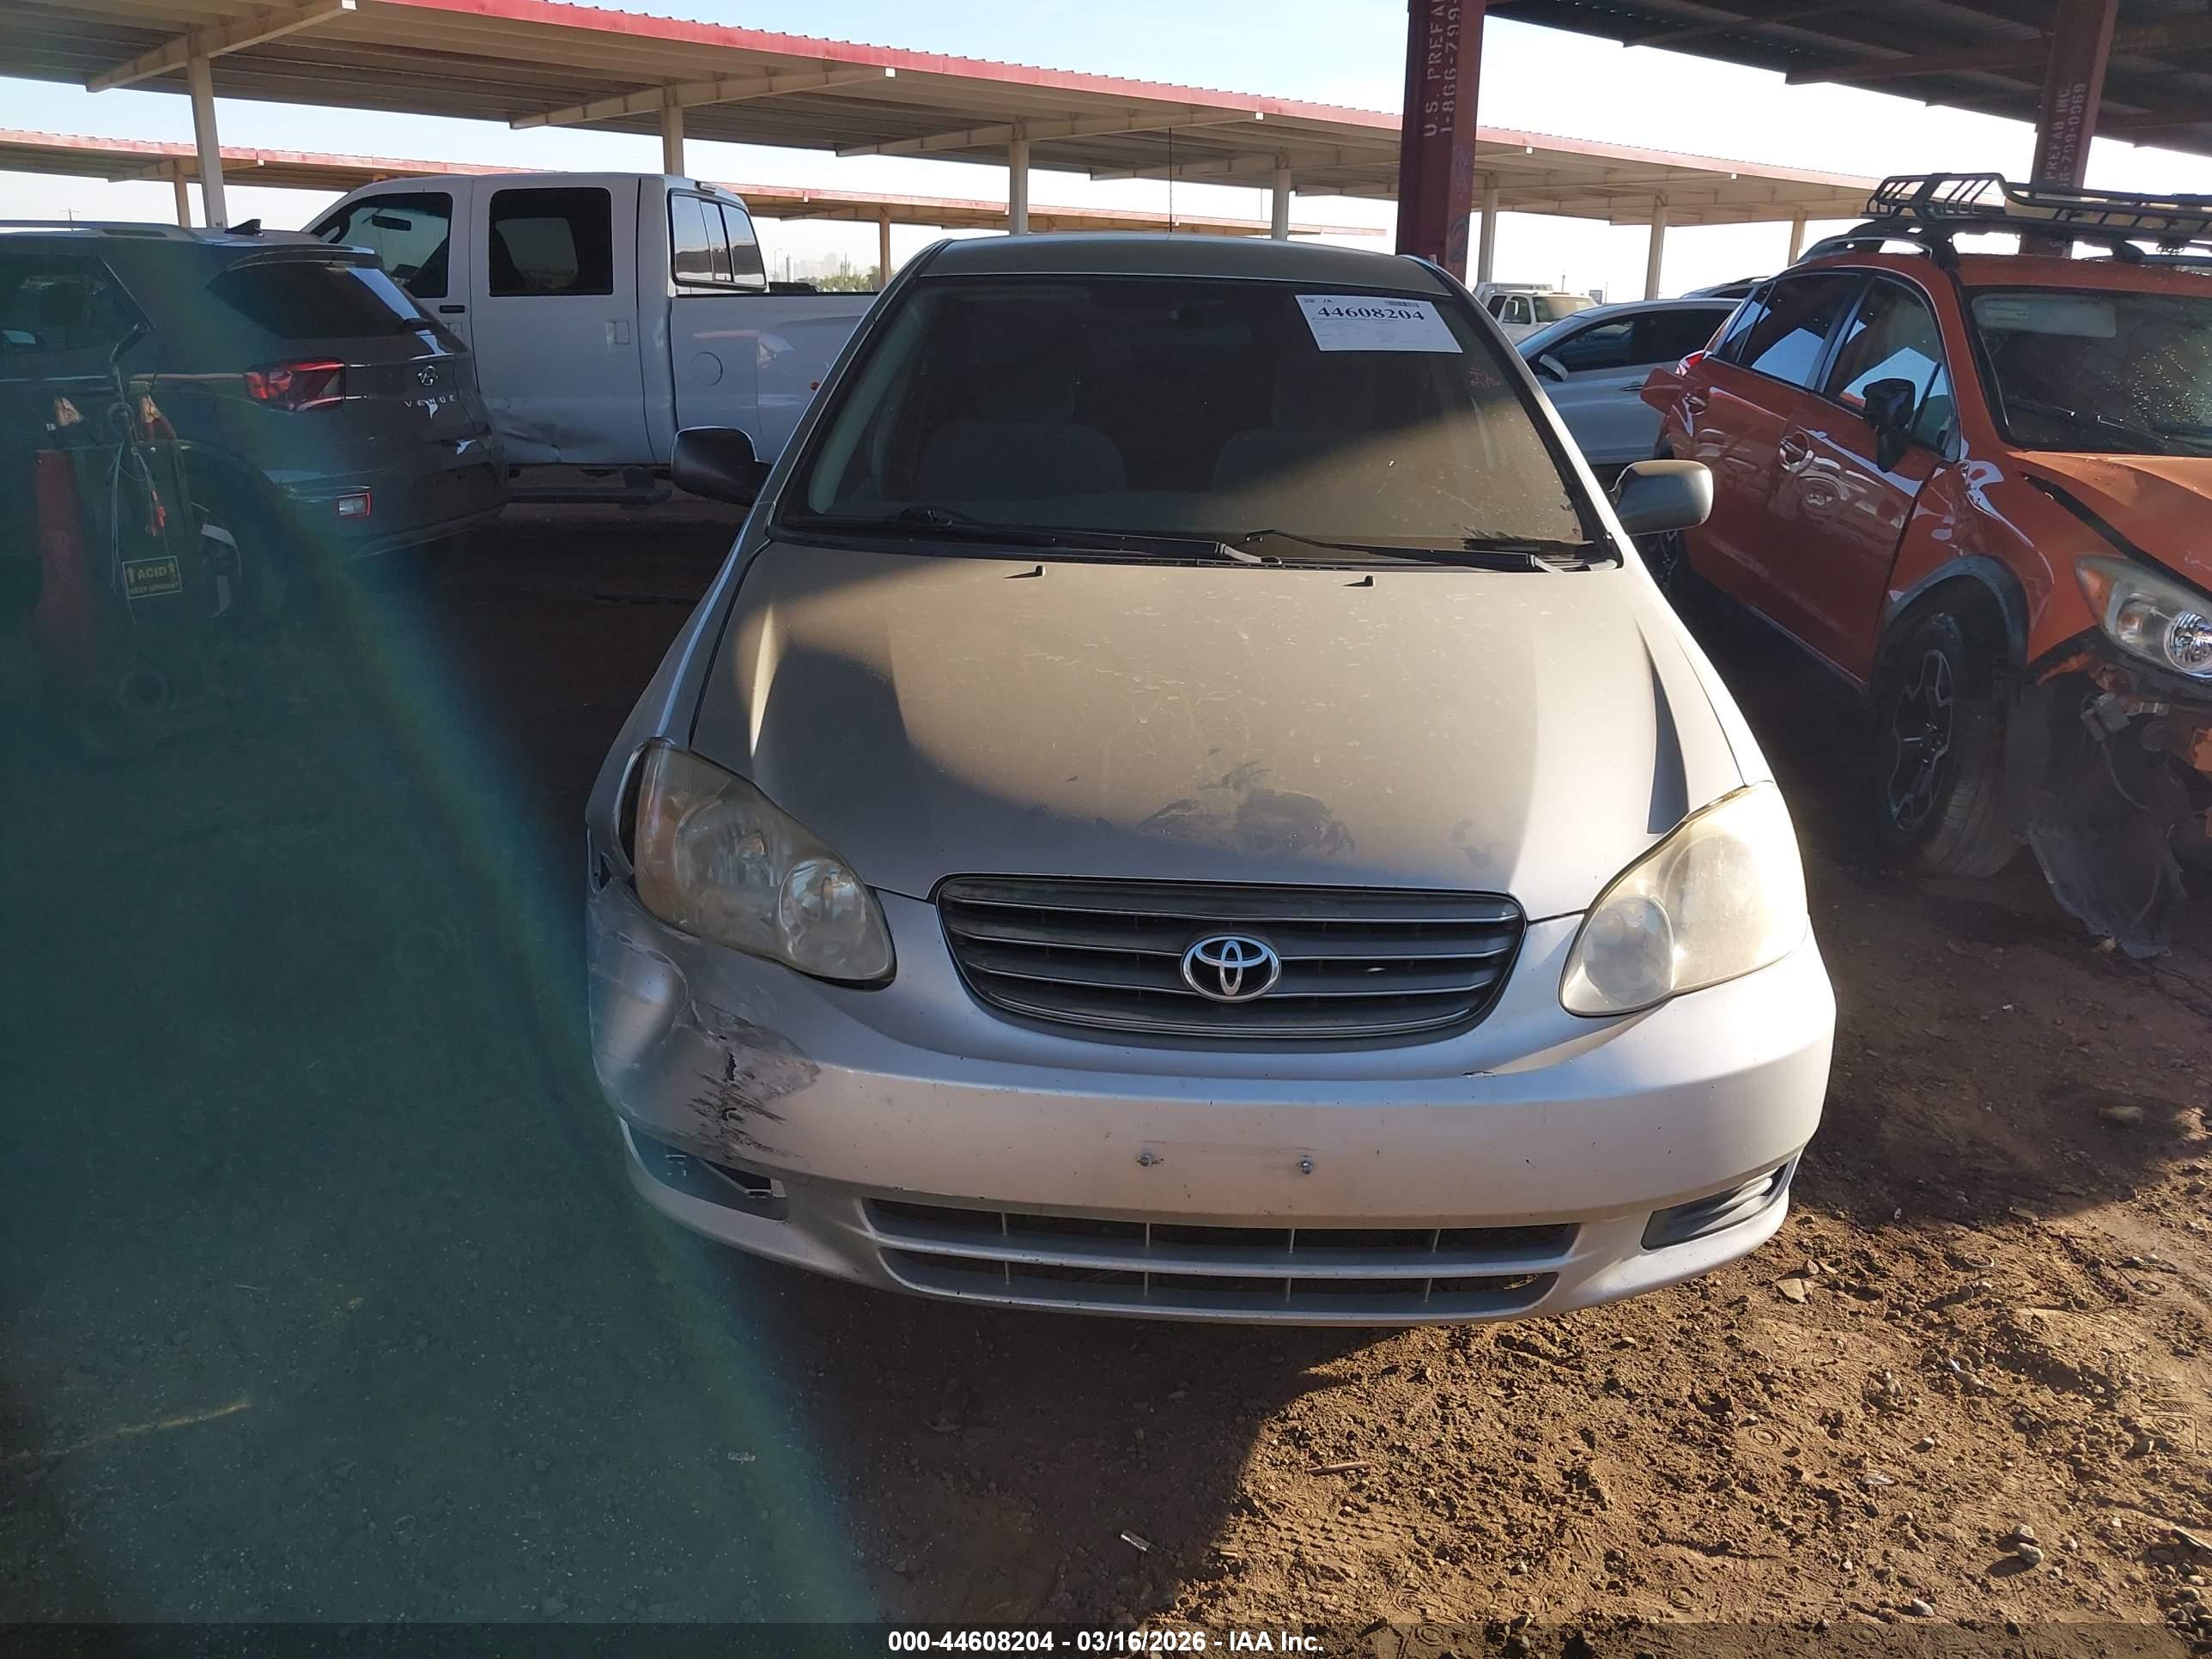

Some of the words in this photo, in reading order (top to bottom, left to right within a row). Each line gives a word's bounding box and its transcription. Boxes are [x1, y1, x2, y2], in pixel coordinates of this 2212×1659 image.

[1427, 0, 1446, 80] PREFA
[1318, 307, 1425, 320] 44608204
[404, 394, 454, 407] VENUE
[138, 567, 167, 580] ACID
